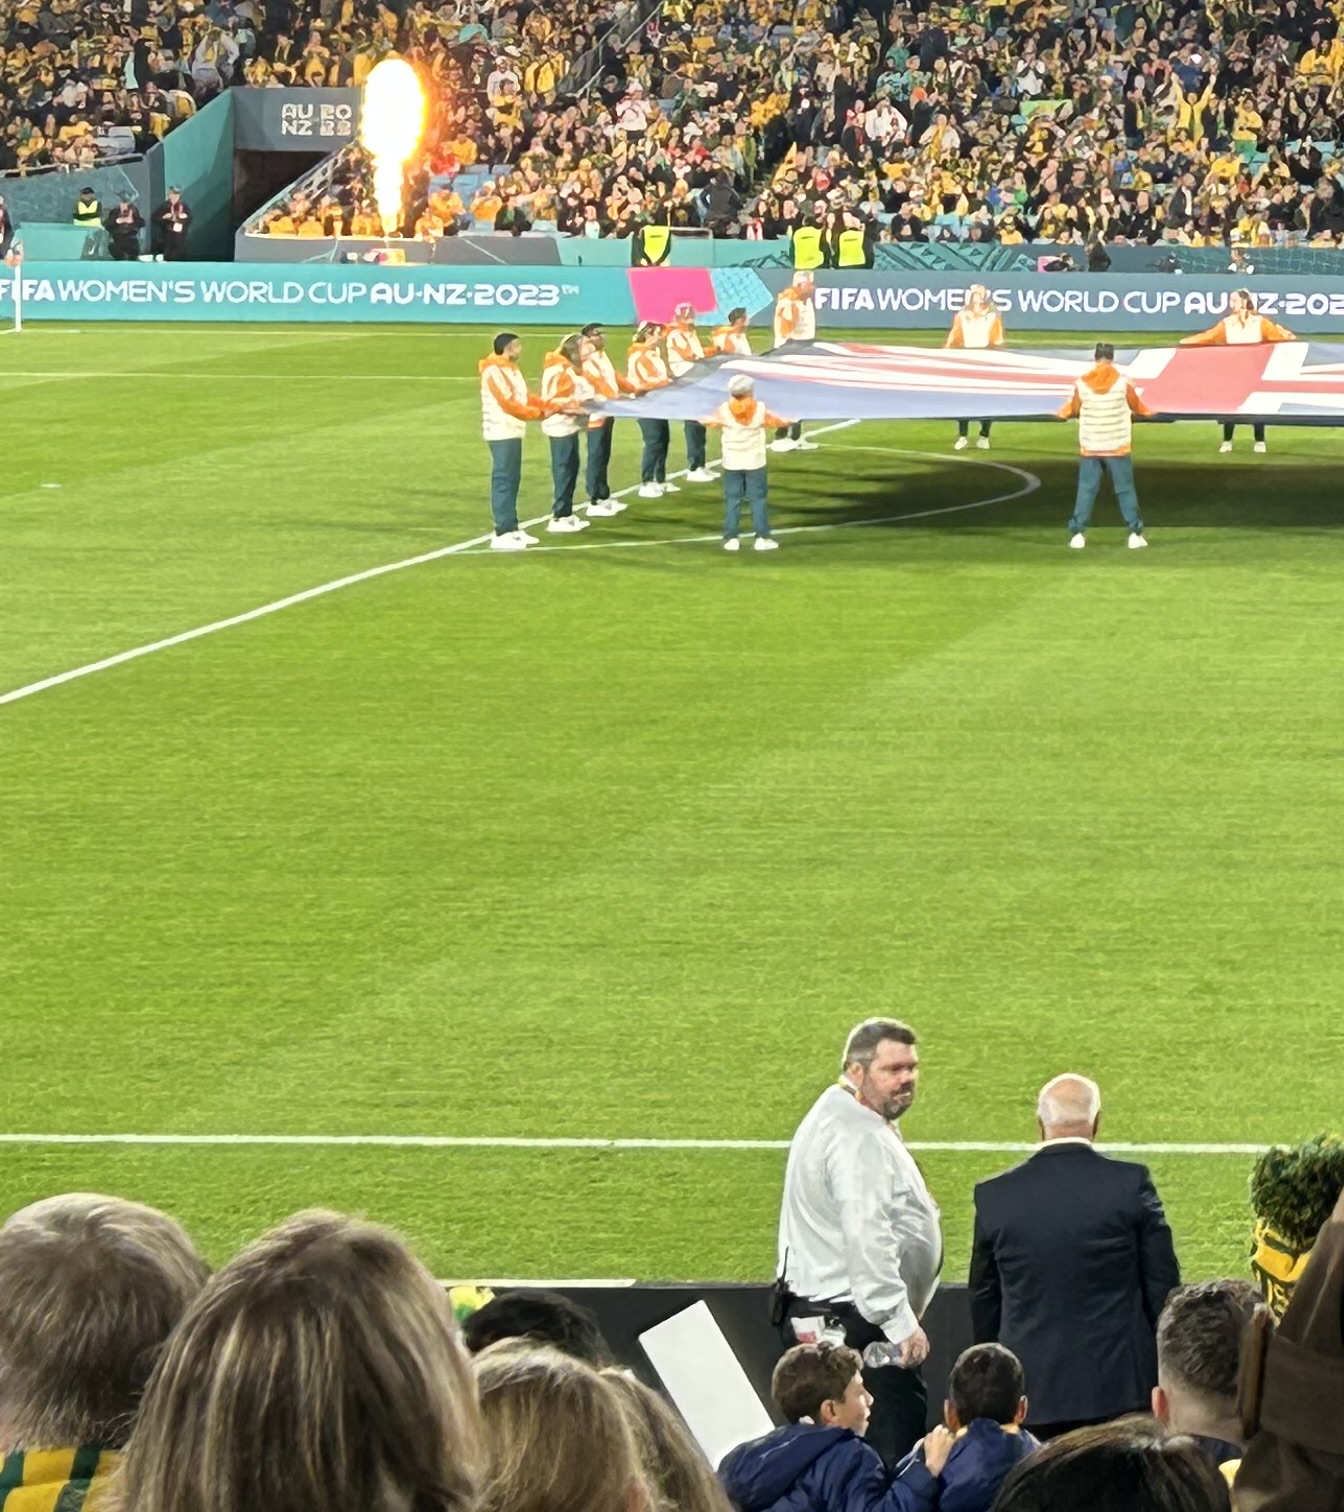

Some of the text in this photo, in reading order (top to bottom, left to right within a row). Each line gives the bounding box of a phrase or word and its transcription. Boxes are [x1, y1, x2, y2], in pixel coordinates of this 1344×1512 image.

[57, 279, 196, 303] WOMEN'S
[200, 281, 304, 304] WORLD
[308, 281, 367, 305] CUP
[815, 287, 875, 310] FIFA
[876, 287, 1012, 311] WOME'S
[1017, 289, 1119, 313] WORLD
[1124, 291, 1181, 314] CUP
